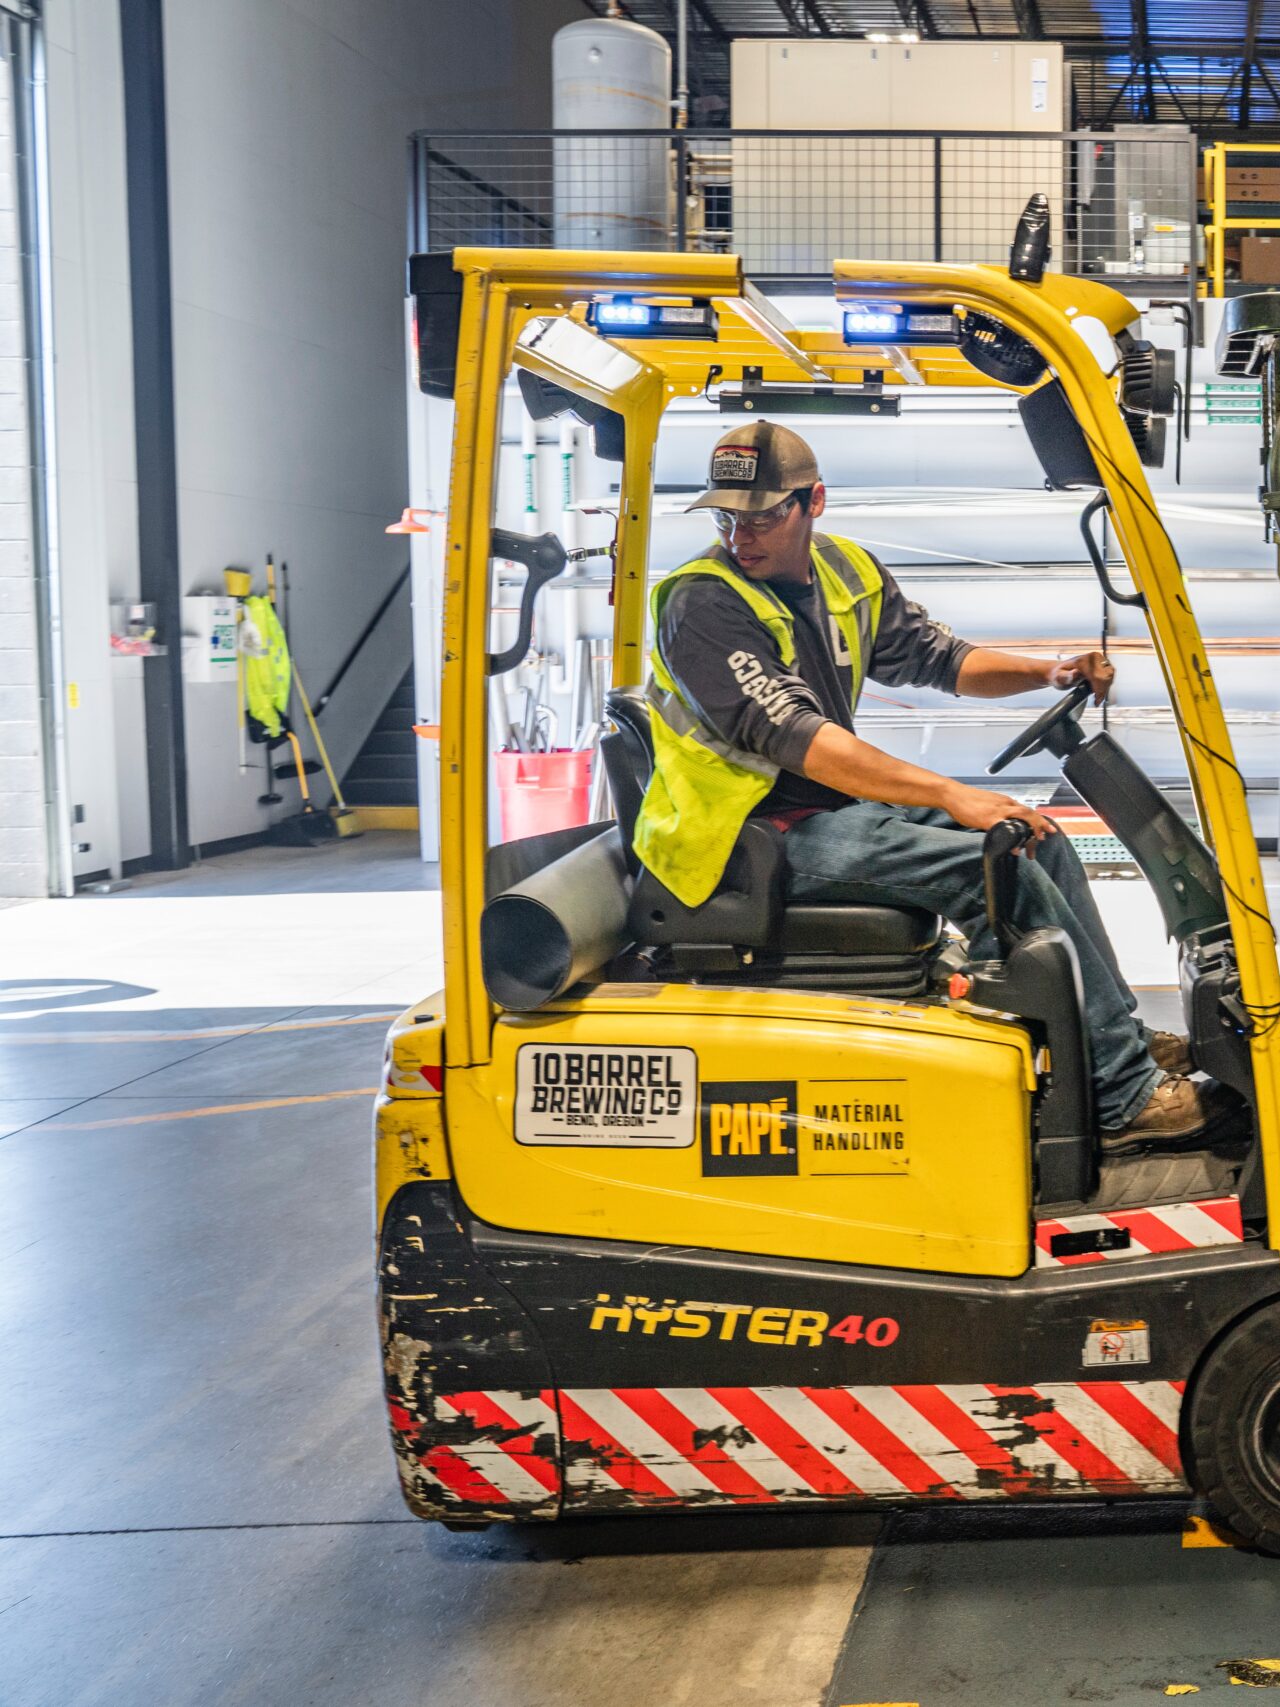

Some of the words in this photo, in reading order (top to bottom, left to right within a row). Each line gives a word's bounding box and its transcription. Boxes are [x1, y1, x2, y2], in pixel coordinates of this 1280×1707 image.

[602, 1115, 644, 1127] OREGON
[813, 1104, 904, 1123] MATERIAL
[813, 1132, 904, 1151] HANDLING
[589, 1293, 829, 1347] HYSTER
[827, 1315, 900, 1347] 40
